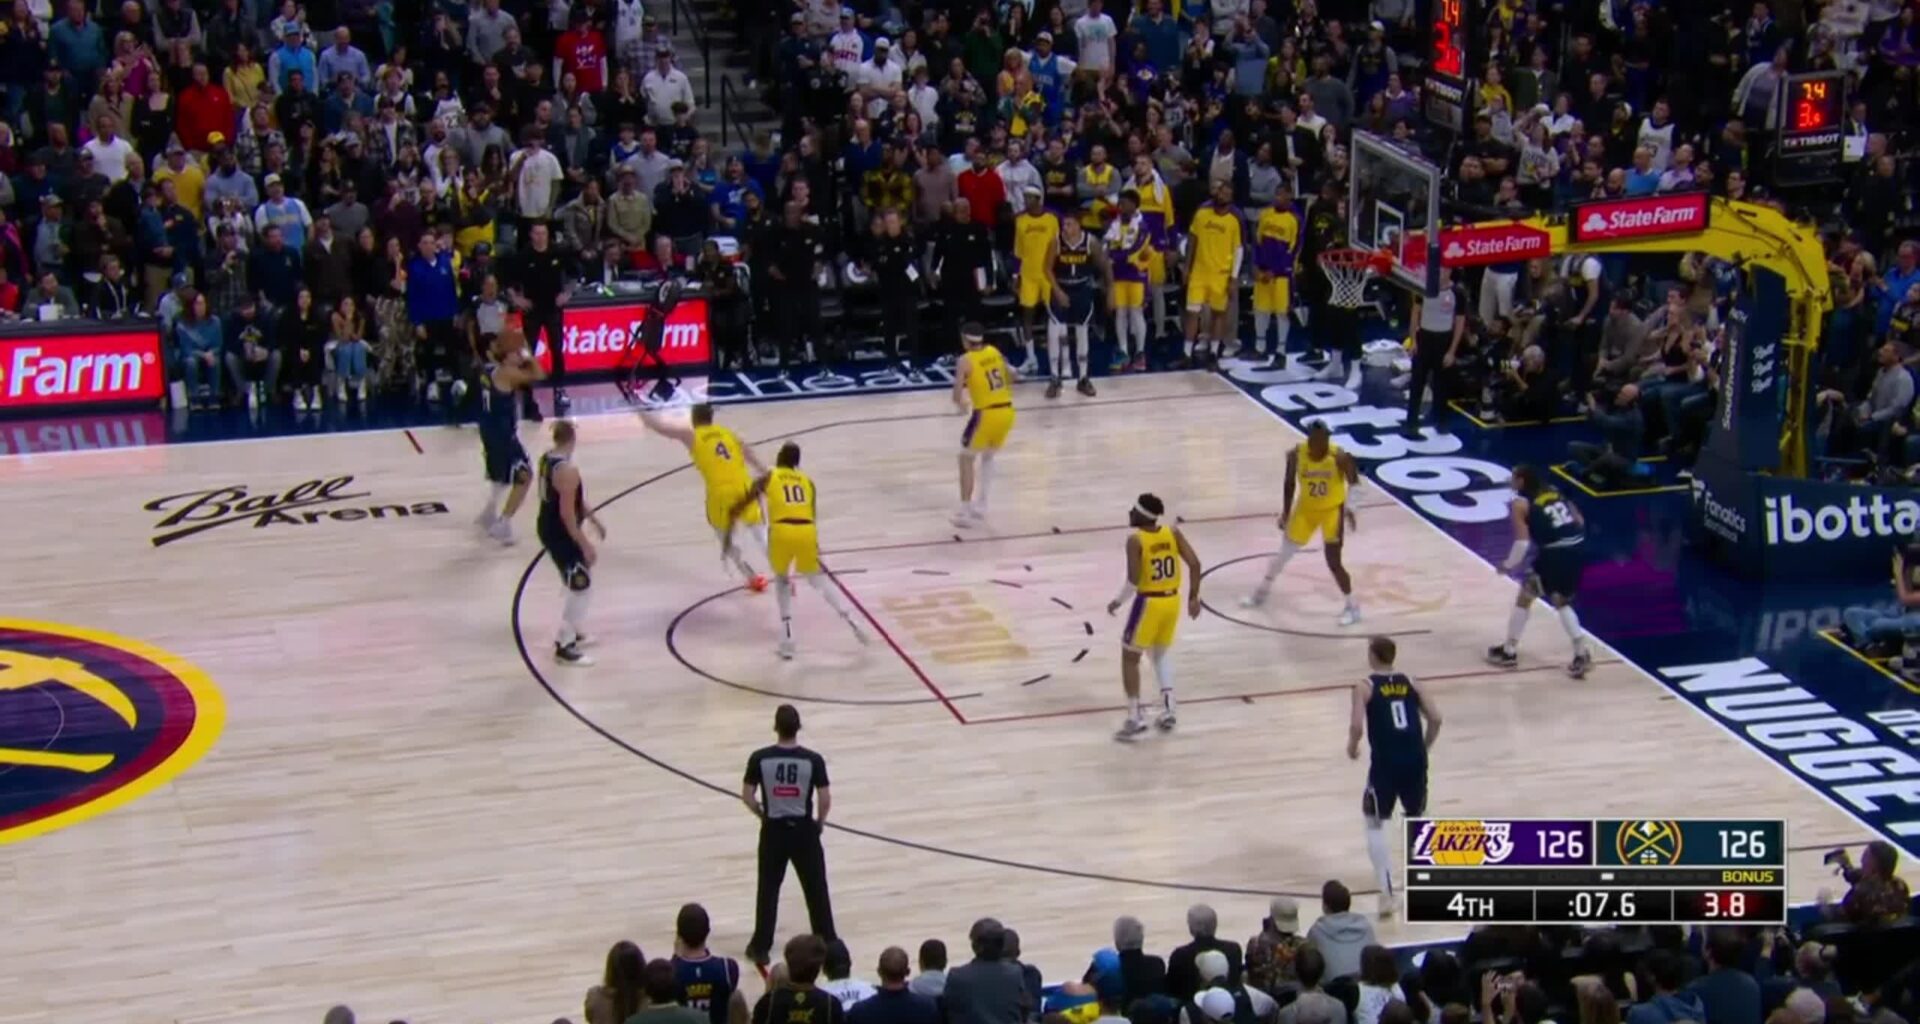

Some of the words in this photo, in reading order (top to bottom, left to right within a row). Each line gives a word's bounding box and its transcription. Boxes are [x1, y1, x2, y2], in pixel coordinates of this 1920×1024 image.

[1799, 132, 1840, 147] TISSOT
[1609, 209, 1652, 229] State
[1653, 206, 1695, 224] Farm
[1466, 240, 1504, 256] State
[1505, 234, 1541, 251] Farm
[9, 346, 142, 398] Farm
[985, 368, 1003, 391] 15
[716, 441, 731, 460] 4
[783, 484, 806, 504] 10
[1308, 481, 1328, 498] 20
[143, 475, 371, 546] Ball
[253, 498, 450, 529] Arena
[1543, 501, 1573, 528] 32
[1704, 491, 1746, 533] Fanatics
[1764, 494, 1920, 545] ibotta
[1151, 555, 1175, 582] 30
[1390, 700, 1408, 730] 0
[1657, 656, 1920, 837] NUGGE
[775, 762, 798, 785] 46
